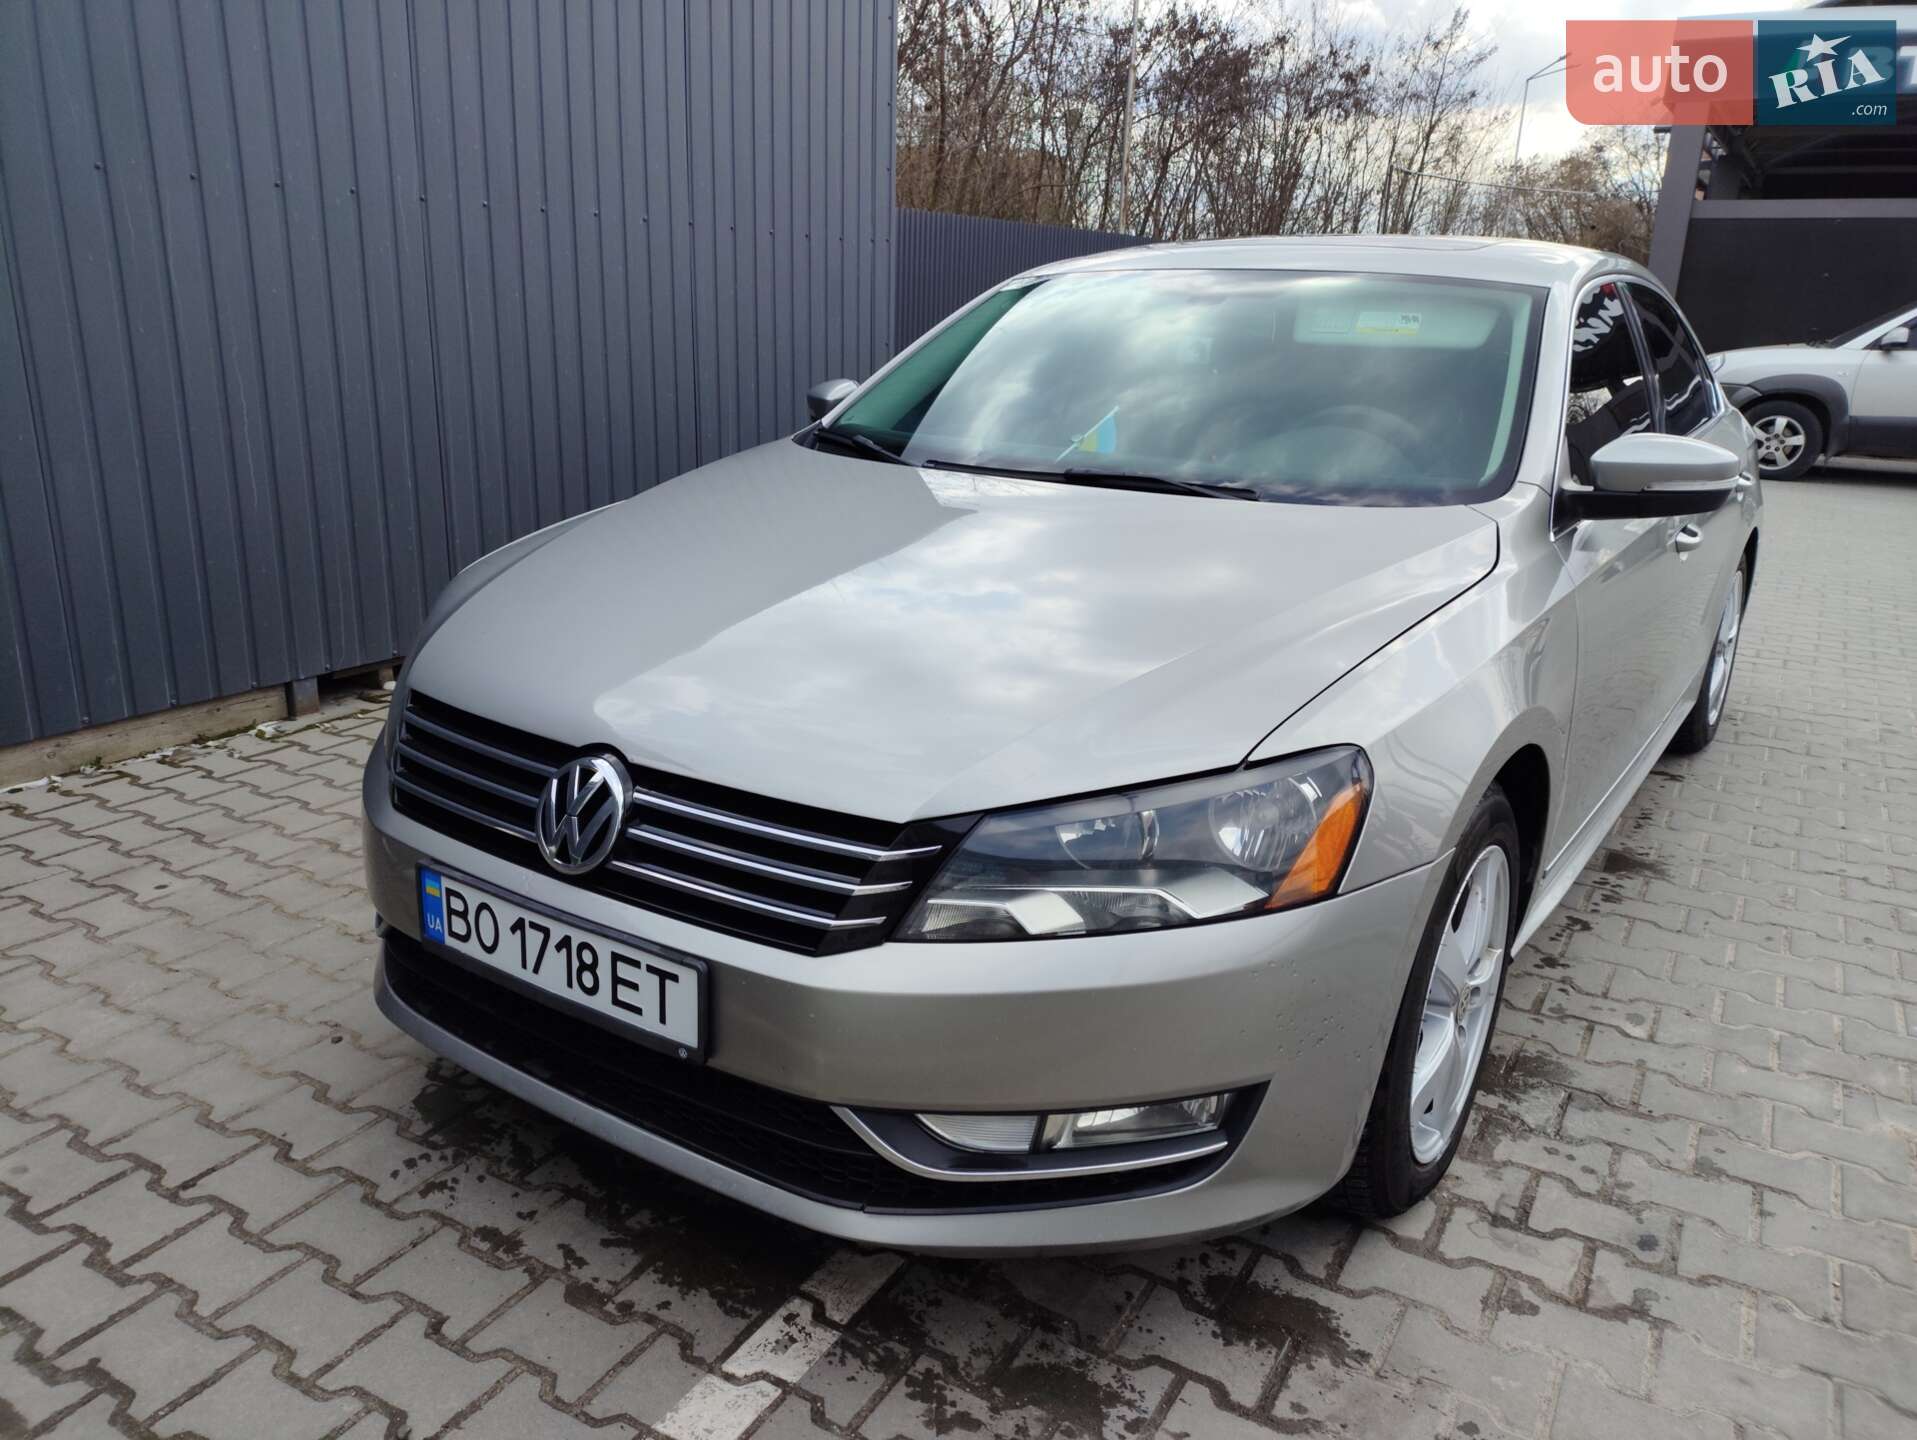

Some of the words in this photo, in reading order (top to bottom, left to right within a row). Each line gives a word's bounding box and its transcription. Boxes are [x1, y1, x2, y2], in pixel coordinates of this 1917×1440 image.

[427, 913, 442, 933] UA
[444, 887, 499, 954] BO
[510, 916, 599, 996] 1718
[610, 951, 679, 1025] ET
